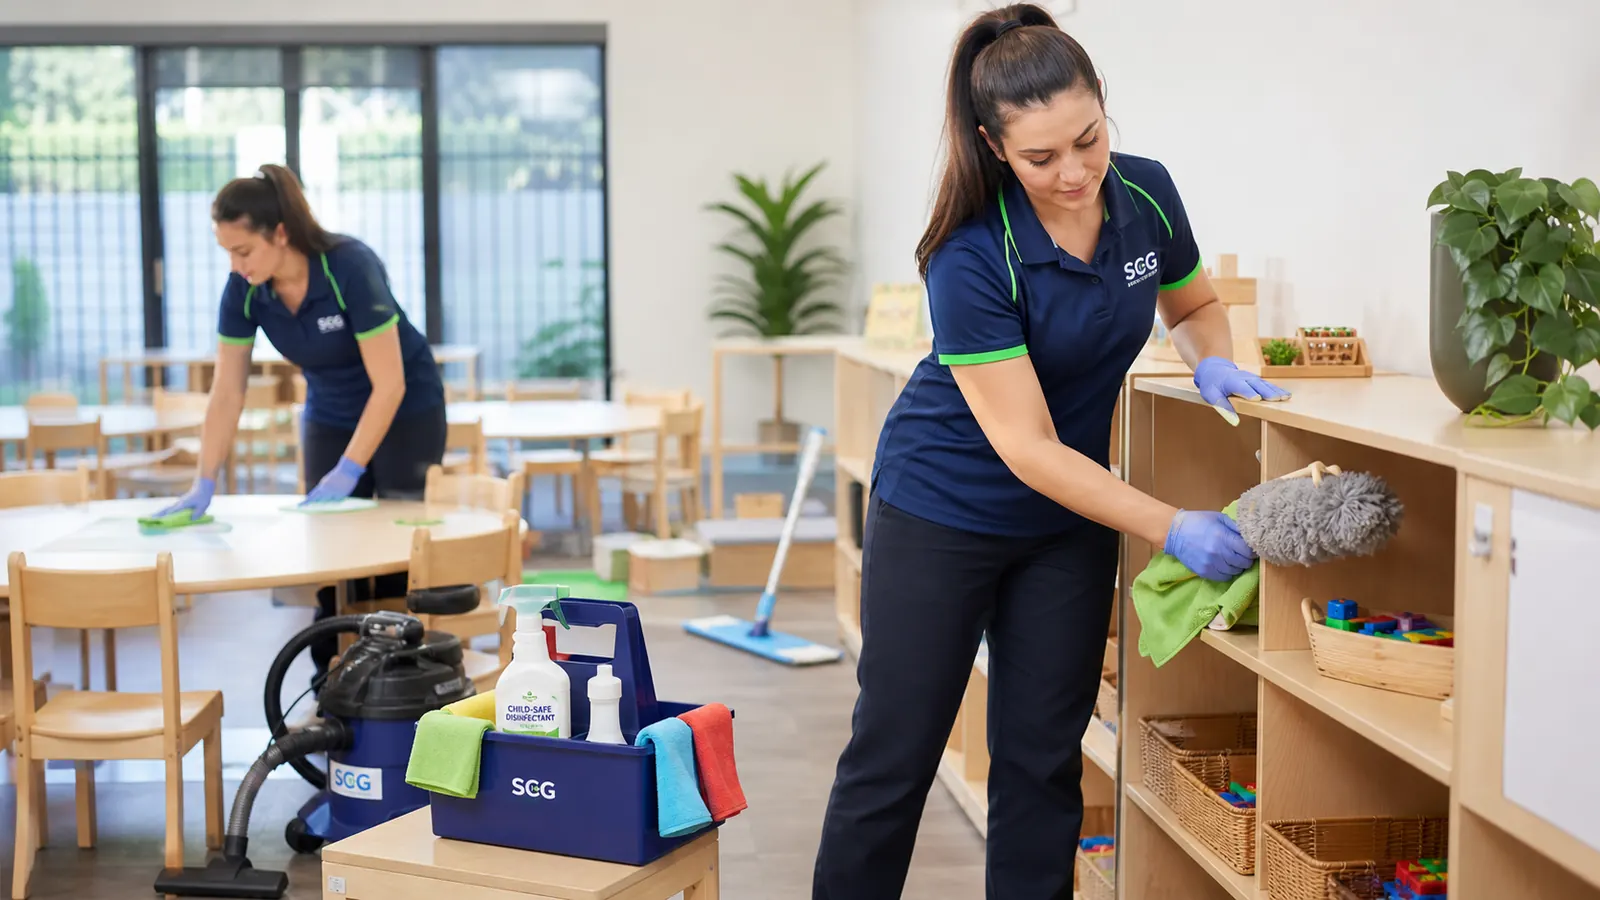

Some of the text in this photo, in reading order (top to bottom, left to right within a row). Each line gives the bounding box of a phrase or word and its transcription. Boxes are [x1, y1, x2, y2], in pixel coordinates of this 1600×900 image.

[1124, 251, 1158, 280] SCG
[505, 713, 556, 722] DISINFECTANT
[507, 704, 552, 714] CHILD-SAFE
[335, 768, 371, 791] SCG
[511, 777, 556, 800] SCG
